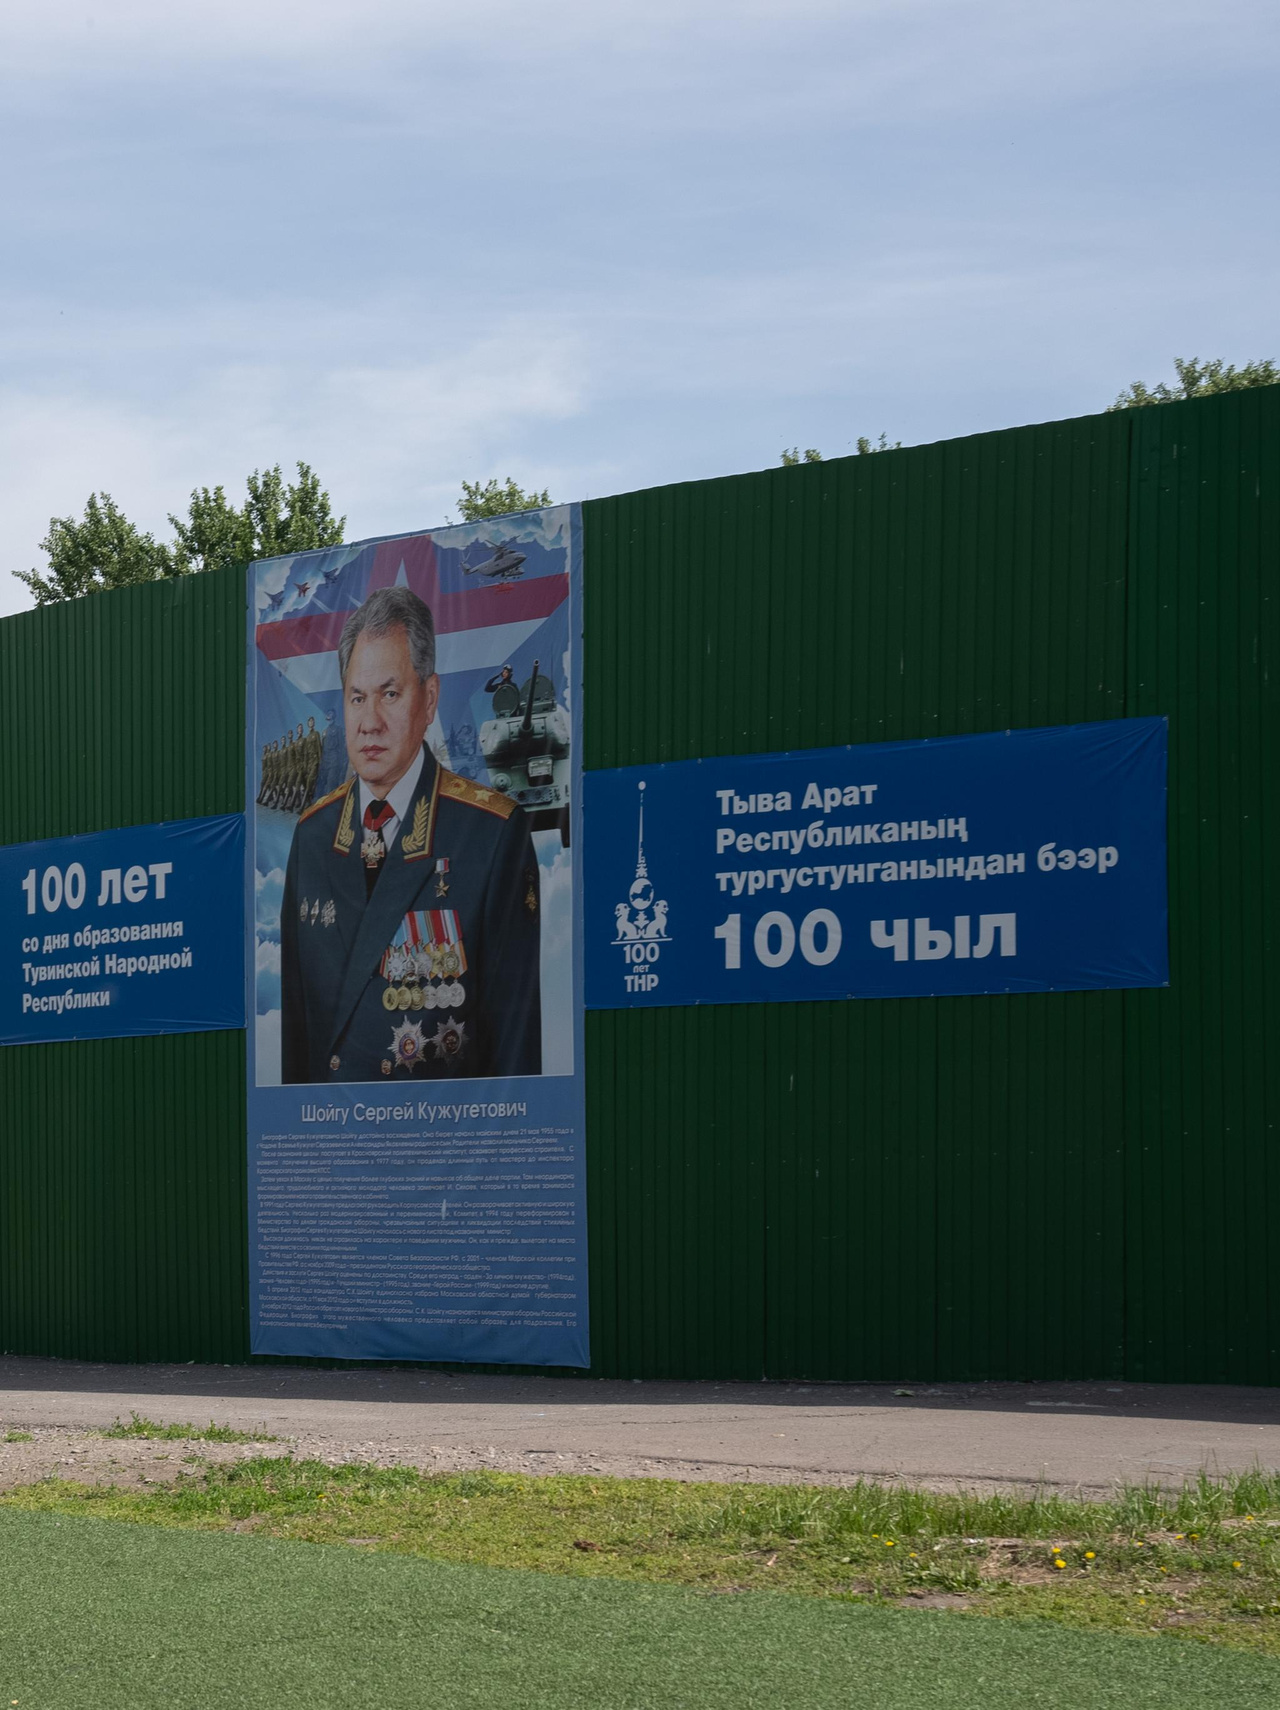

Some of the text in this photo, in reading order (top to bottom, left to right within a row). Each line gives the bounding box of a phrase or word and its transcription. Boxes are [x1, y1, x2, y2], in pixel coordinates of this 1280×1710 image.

[716, 784, 878, 816] Тыва Арат
[716, 817, 968, 854] Республиканың
[716, 841, 1119, 896] тургустунганындан бээр
[22, 862, 173, 915] 100 лет
[22, 920, 184, 954] со дня образования
[622, 942, 660, 964] 100
[714, 908, 1017, 969] 100 чыл
[22, 947, 193, 985] Тувинской Народной
[632, 964, 650, 974] лет
[624, 973, 660, 993] ТНР
[22, 988, 111, 1015] Республики
[301, 1101, 527, 1125] Шойгу Сергей Кужугетович
